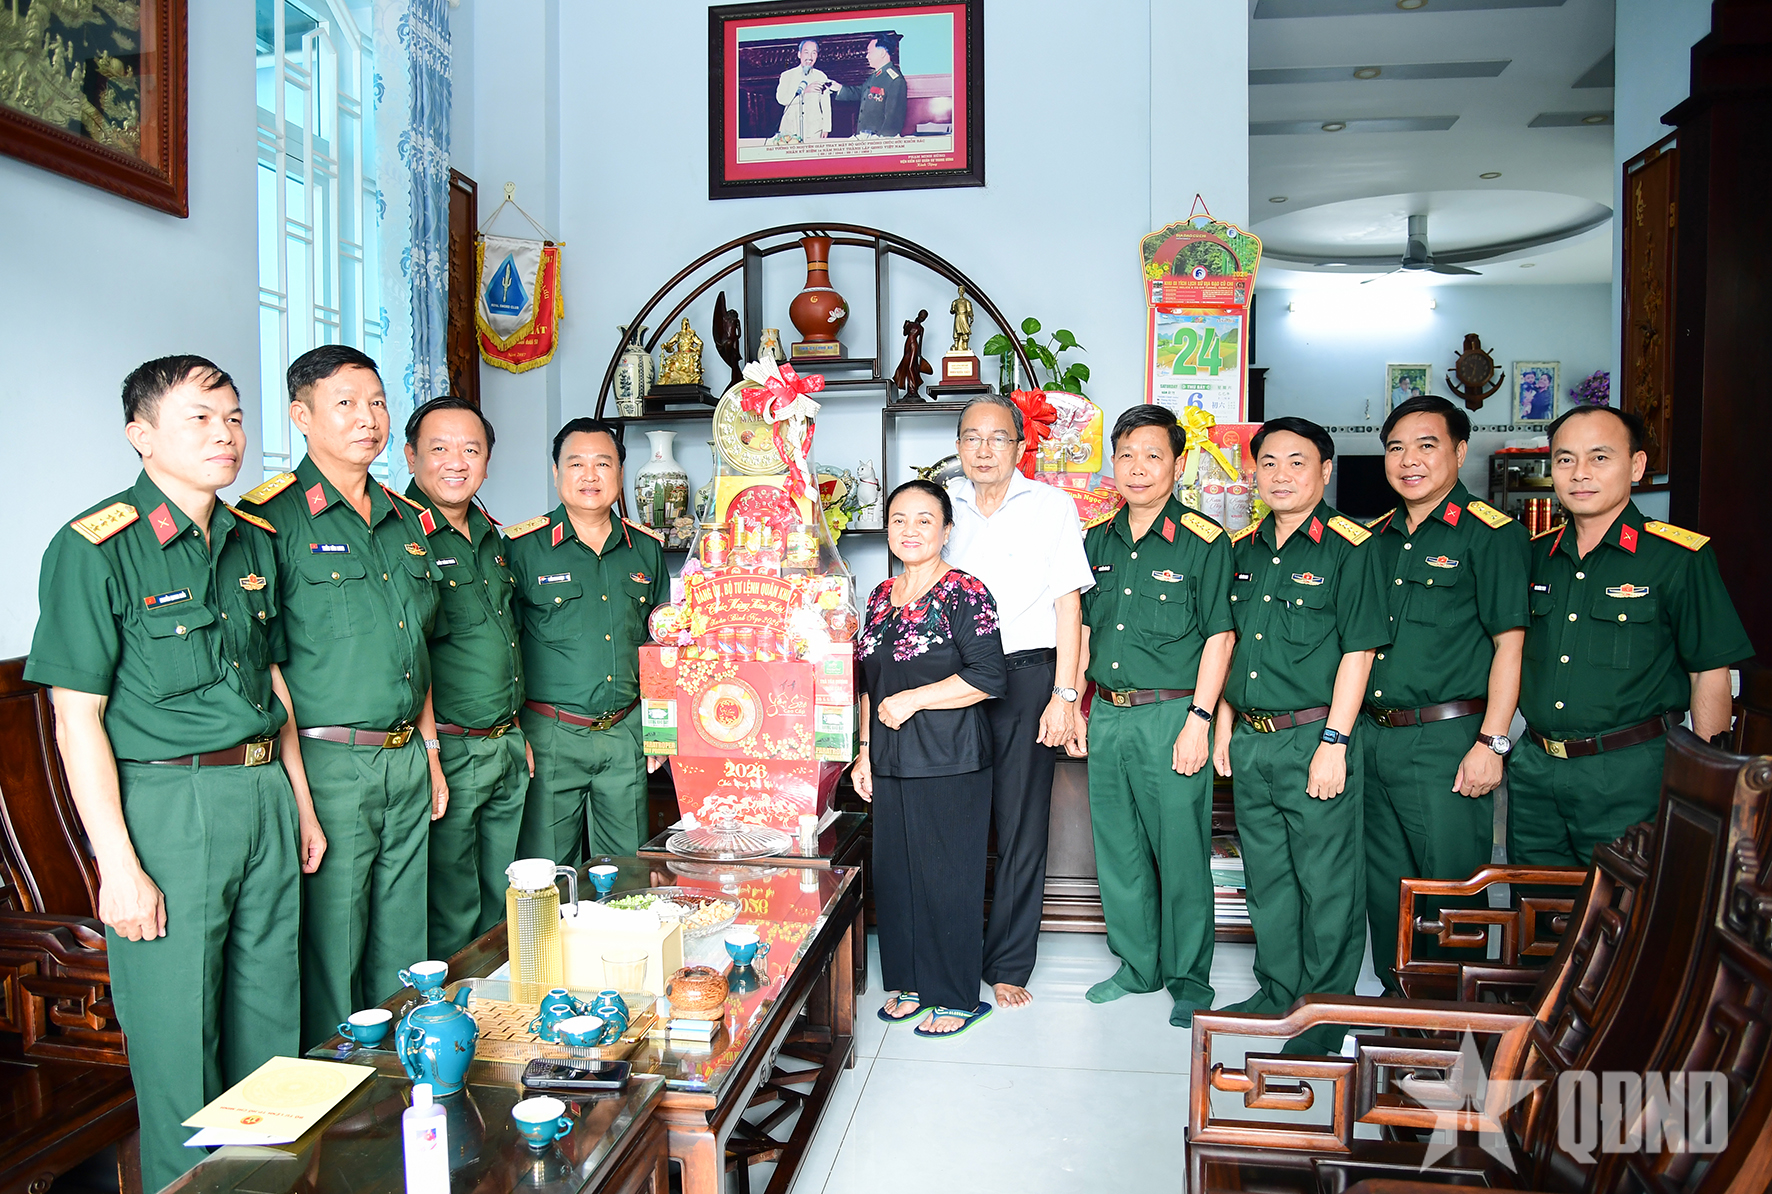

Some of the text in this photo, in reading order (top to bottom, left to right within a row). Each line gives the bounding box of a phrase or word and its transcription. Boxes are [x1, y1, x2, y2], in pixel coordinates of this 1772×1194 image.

[1172, 327, 1223, 376] 24
[1187, 392, 1203, 410] 6
[723, 580, 733, 597] BỘ
[734, 580, 743, 594] TƯ
[743, 579, 760, 596] LỆNH
[760, 582, 779, 597] QUÂN
[790, 592, 798, 604] 7
[762, 617, 780, 627] 2026
[724, 761, 768, 779] 2026
